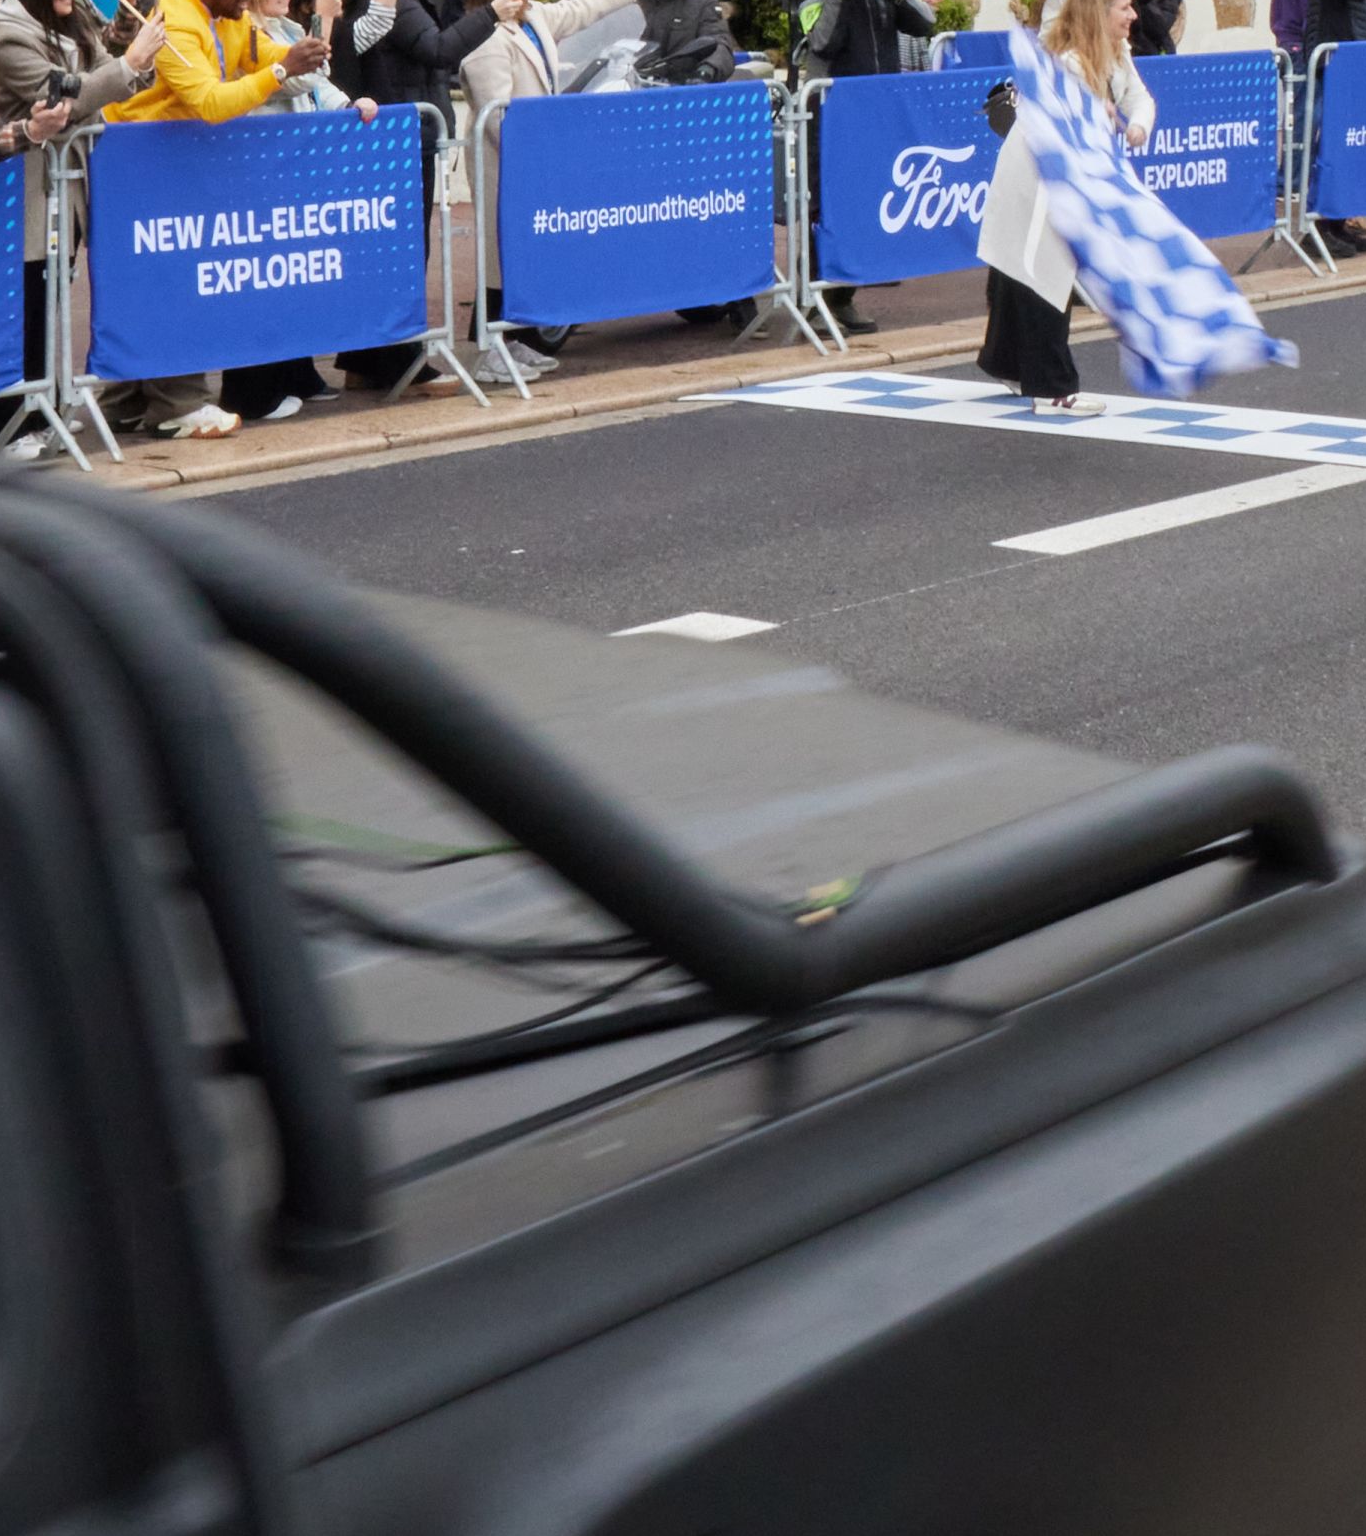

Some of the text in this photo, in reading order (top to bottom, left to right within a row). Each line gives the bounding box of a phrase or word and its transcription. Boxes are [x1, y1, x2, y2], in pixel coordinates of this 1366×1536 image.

[1154, 120, 1259, 155] ALL-ELECTRIC
[1144, 158, 1227, 191] EXPLORER
[134, 196, 396, 254] NEW ALL-ELECTRIC
[533, 188, 745, 235] #chargearoundtheglobe
[197, 248, 343, 296] EXPLORER
